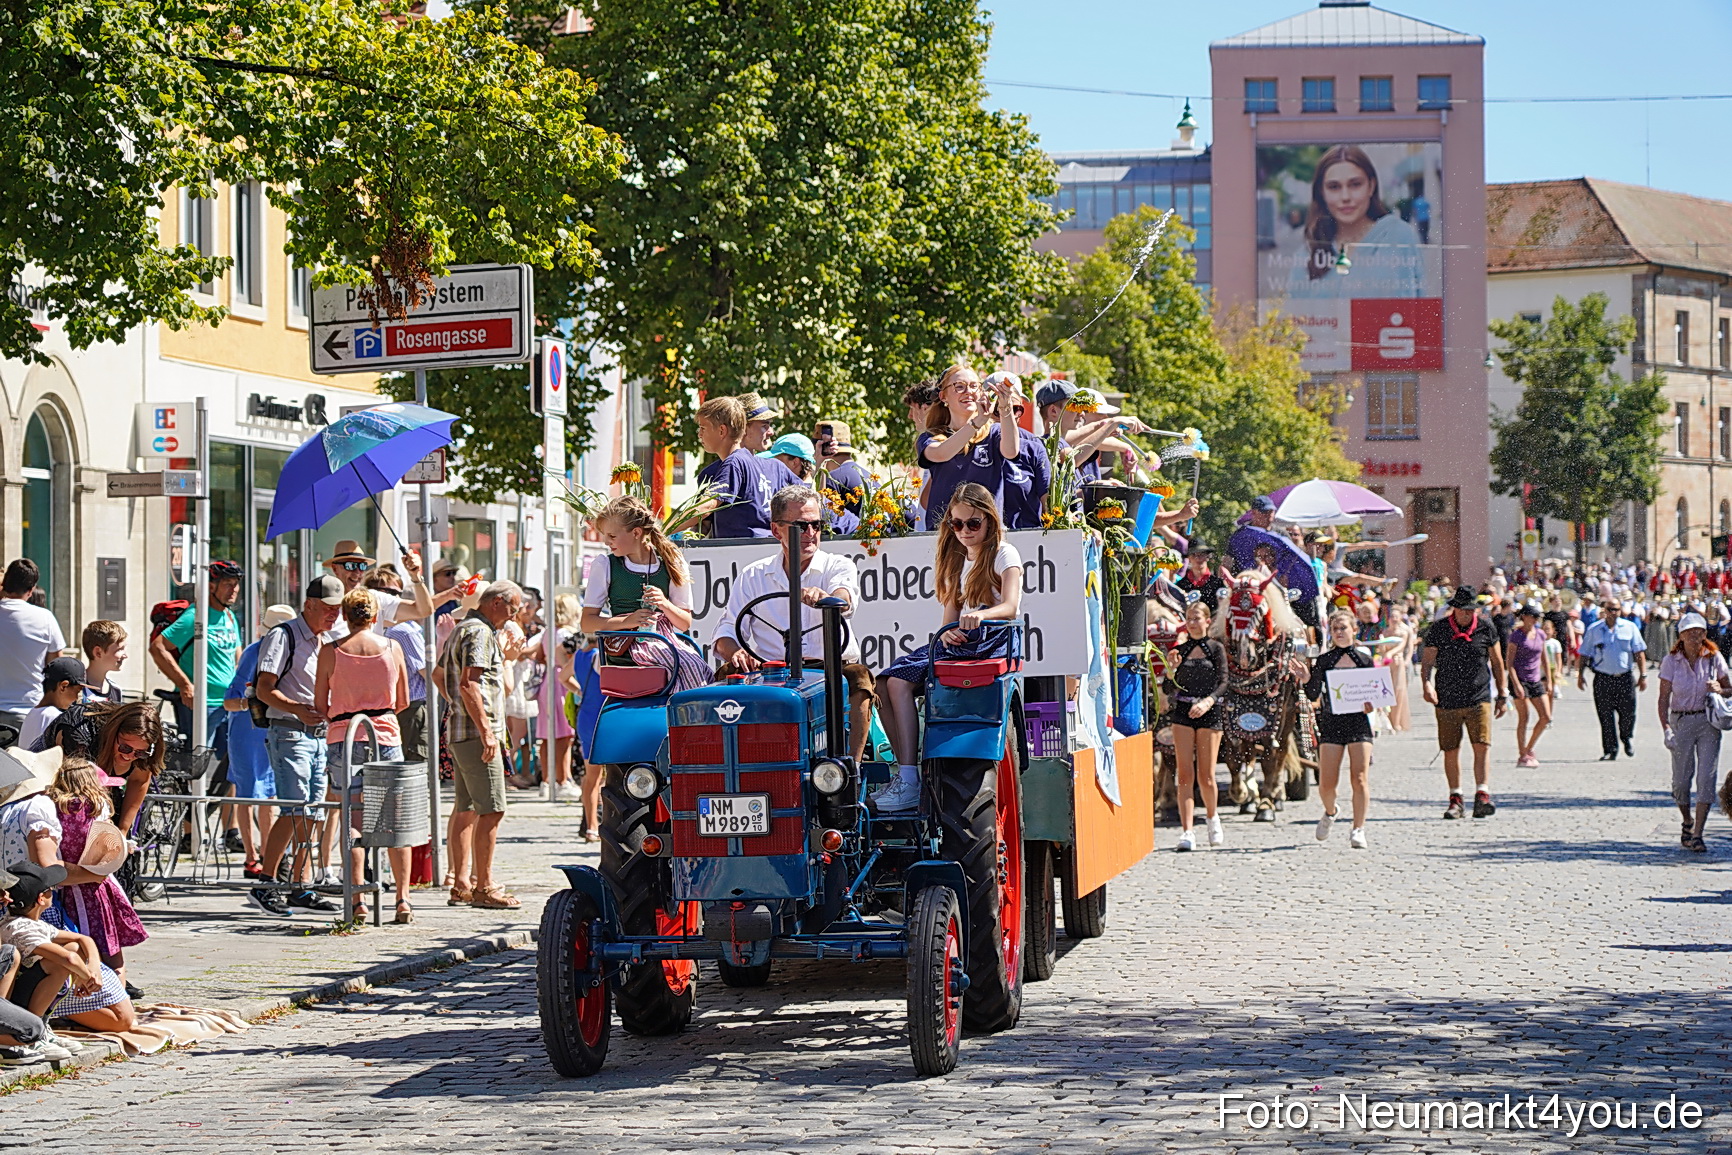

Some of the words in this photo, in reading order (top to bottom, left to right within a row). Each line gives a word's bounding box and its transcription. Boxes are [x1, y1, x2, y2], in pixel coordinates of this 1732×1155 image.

[363, 337, 376, 357] P
[396, 328, 487, 350] Rosengasse
[155, 408, 176, 429] EC
[711, 799, 733, 815] NM
[705, 816, 750, 832] M989
